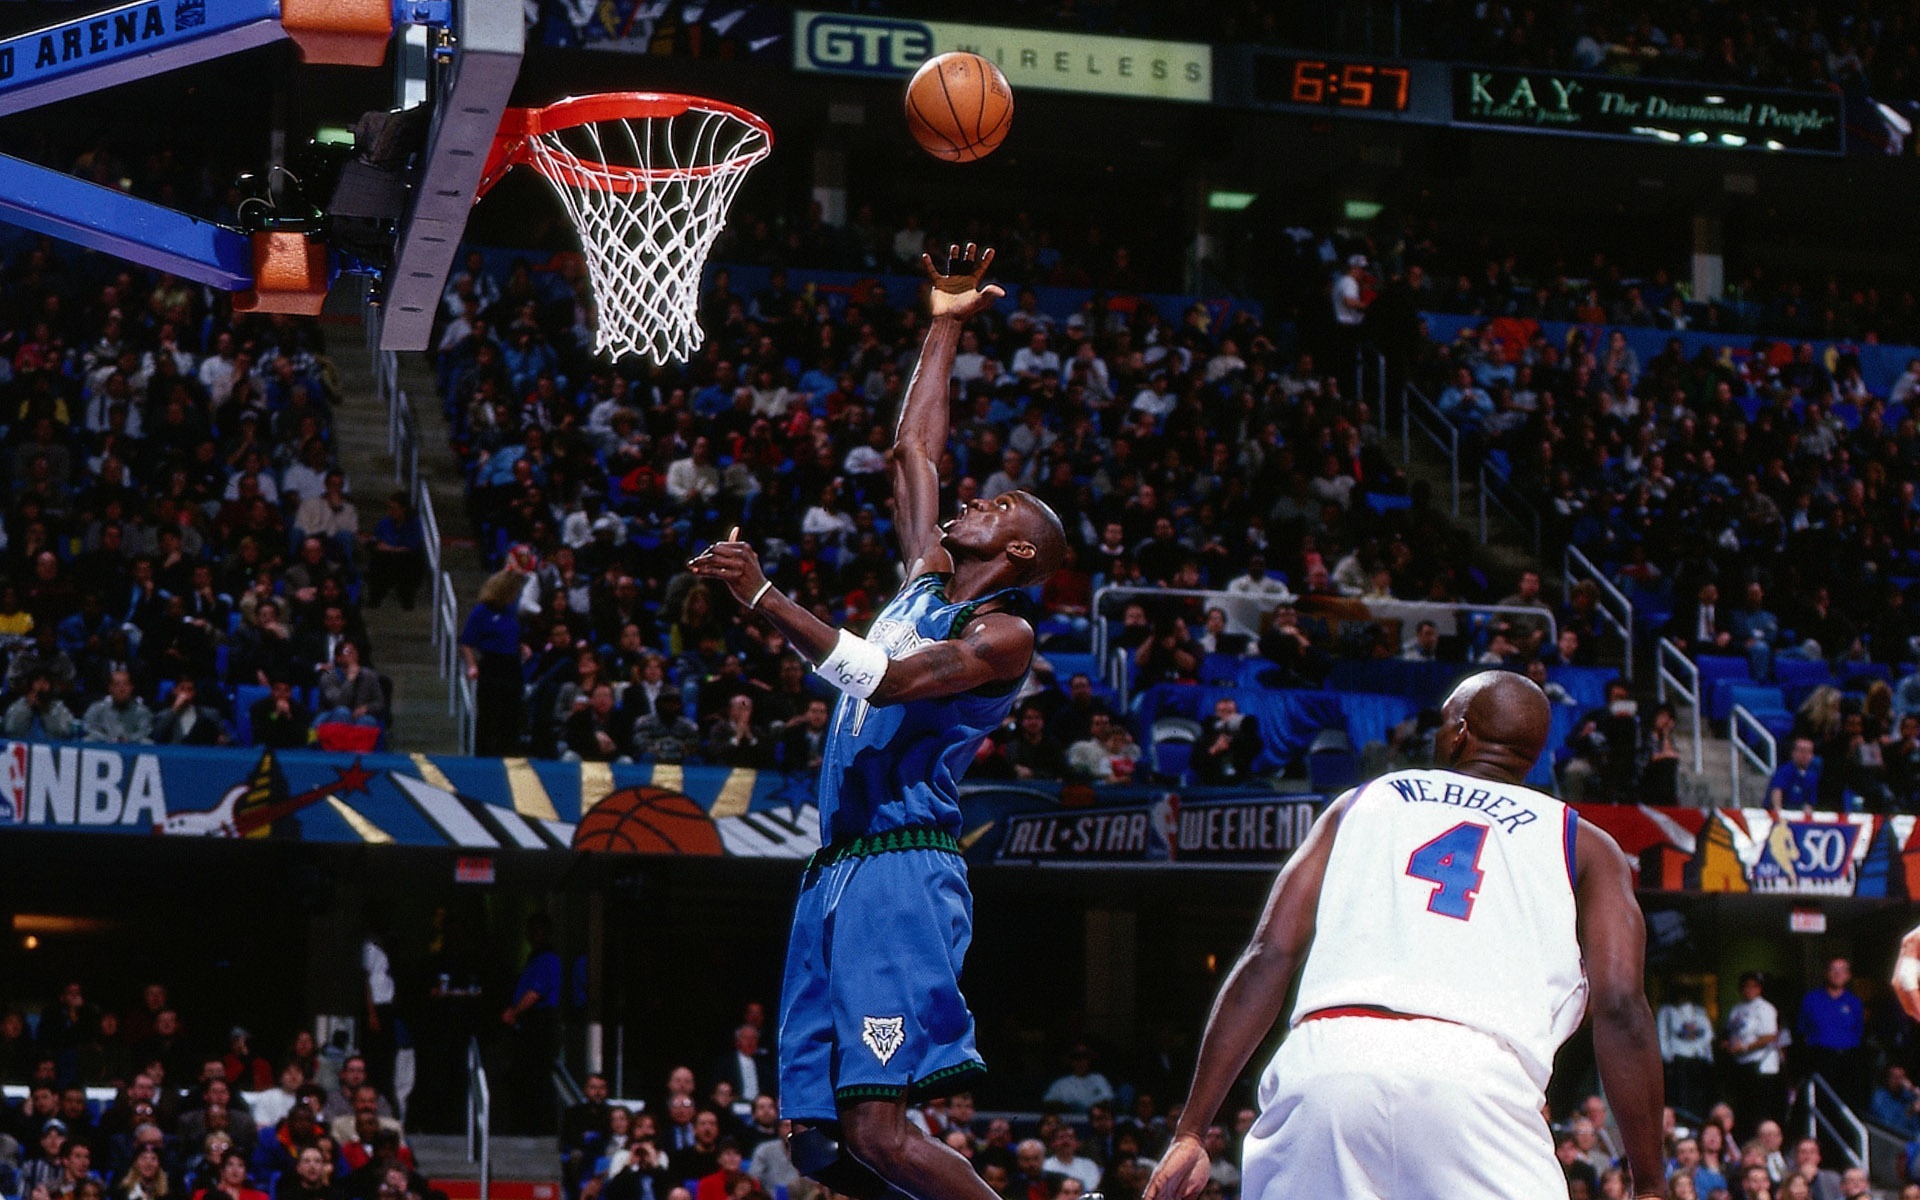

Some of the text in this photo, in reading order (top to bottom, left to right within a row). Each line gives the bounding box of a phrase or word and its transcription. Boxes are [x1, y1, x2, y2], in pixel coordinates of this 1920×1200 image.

[35, 5, 164, 69] ARENA
[814, 27, 931, 68] GTE
[1293, 60, 1410, 110] 6:57
[1471, 72, 1578, 110] KAY
[1600, 92, 1639, 115] The
[1646, 96, 1752, 124] Diamond
[1757, 103, 1829, 135] People
[28, 745, 166, 825] NBA
[1388, 778, 1538, 834] WEBBER
[1178, 804, 1314, 850] WEEKEND
[1796, 828, 1846, 874] 50
[1405, 820, 1490, 922] 4
